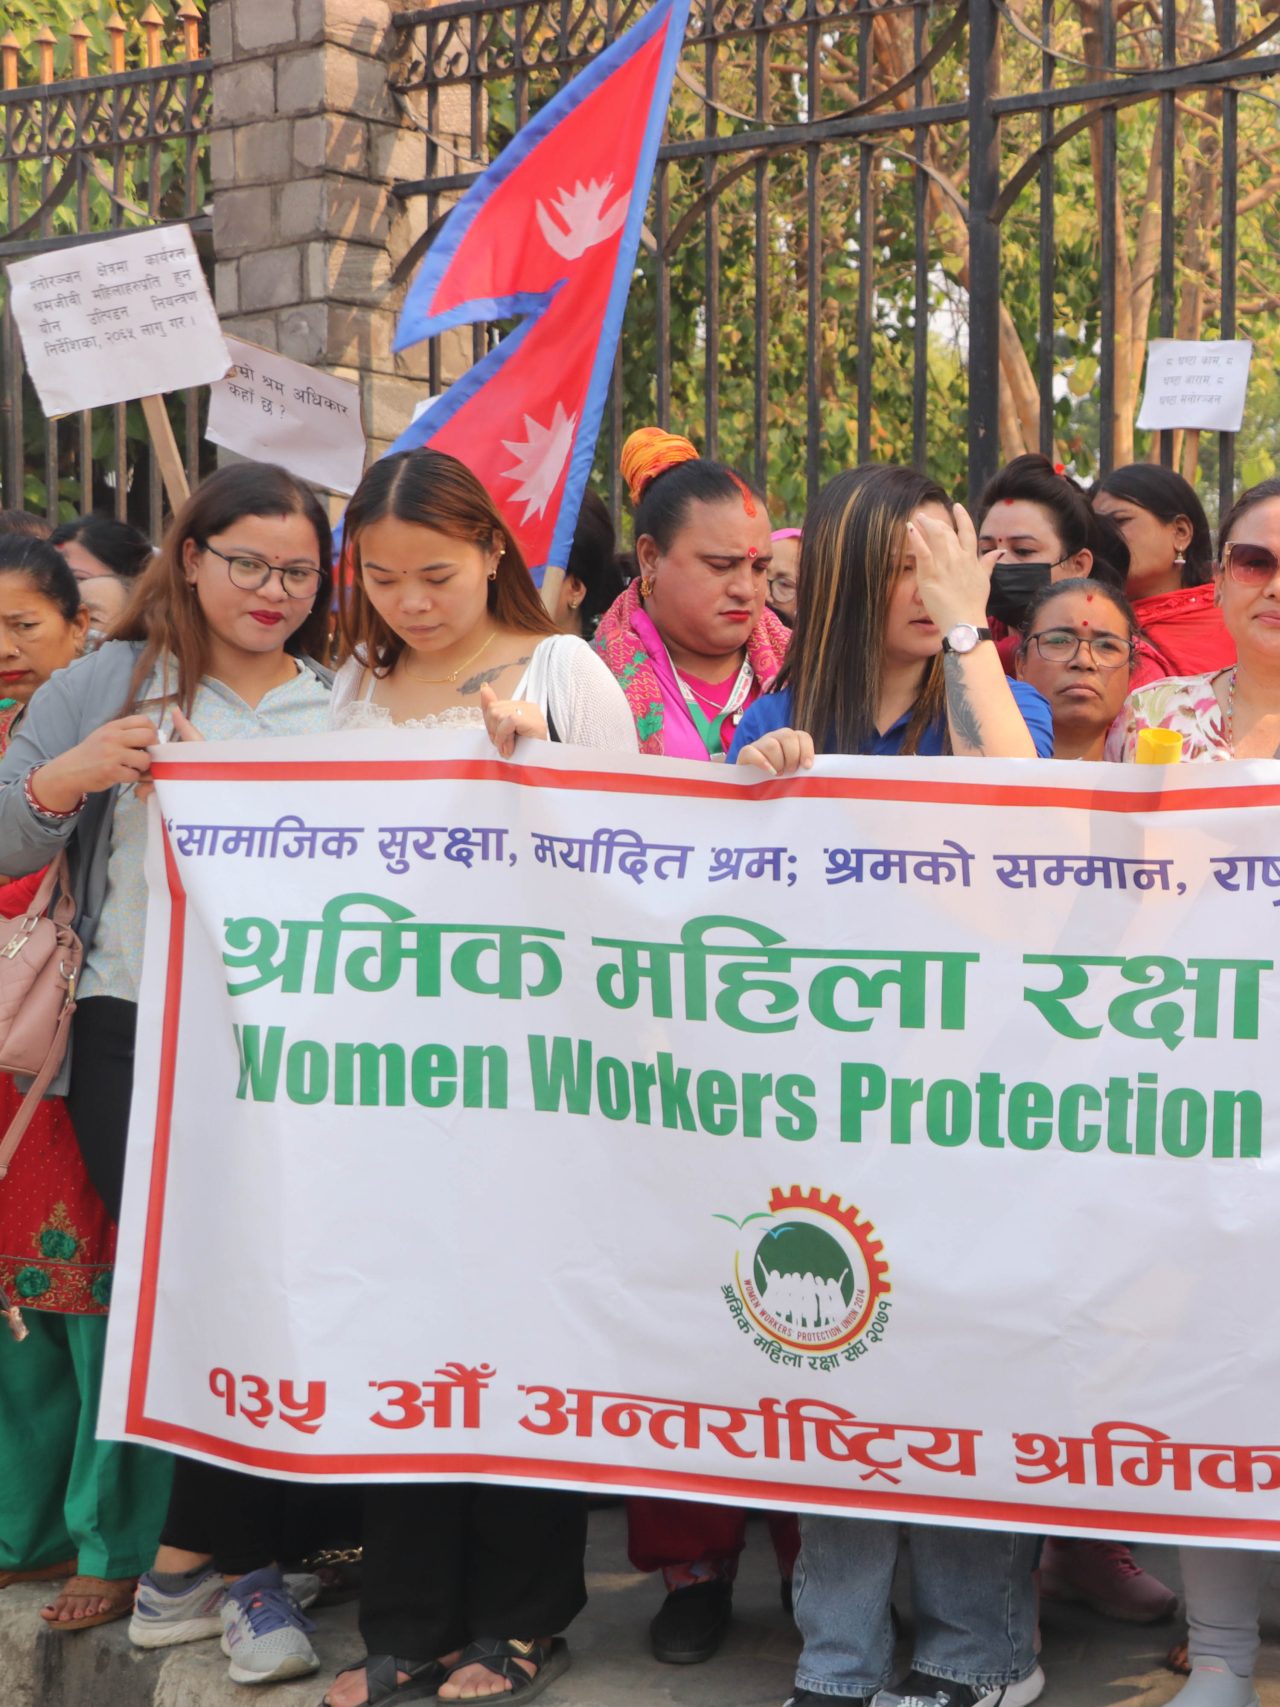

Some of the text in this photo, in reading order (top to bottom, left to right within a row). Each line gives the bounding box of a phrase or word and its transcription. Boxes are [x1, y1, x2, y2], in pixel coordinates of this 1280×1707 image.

[97, 260, 128, 277] क्षेत्रमा
[144, 247, 187, 266] कार्यरत
[33, 292, 82, 314] श्रमजीवी
[39, 319, 62, 336] यौन
[151, 291, 200, 311] नियन्त्रण
[168, 317, 186, 331] गर
[260, 396, 273, 416] छ
[262, 374, 285, 396] श्रम
[293, 386, 350, 417] अधिकार
[378, 826, 518, 875] सुरक्षा,
[532, 828, 695, 885] मर्यादित
[708, 845, 798, 889] श्रम;
[823, 840, 975, 888] श्रमको
[993, 853, 1187, 897] सम्मान,
[223, 893, 565, 999] श्रमिक
[591, 915, 980, 1034] महिला
[1023, 950, 1274, 1052] रक्षा
[234, 1024, 508, 1109] Women
[528, 1035, 817, 1142] Workers
[840, 1062, 1262, 1159] Protection
[721, 1283, 893, 1373] श्रमिक महिला रक्षा संघ २०७१
[744, 1279, 761, 1309] WOMEN
[797, 1326, 842, 1343] PROTECTION
[841, 1310, 858, 1330] UNION
[853, 1289, 866, 1310] 2014
[208, 1366, 327, 1434] १३५
